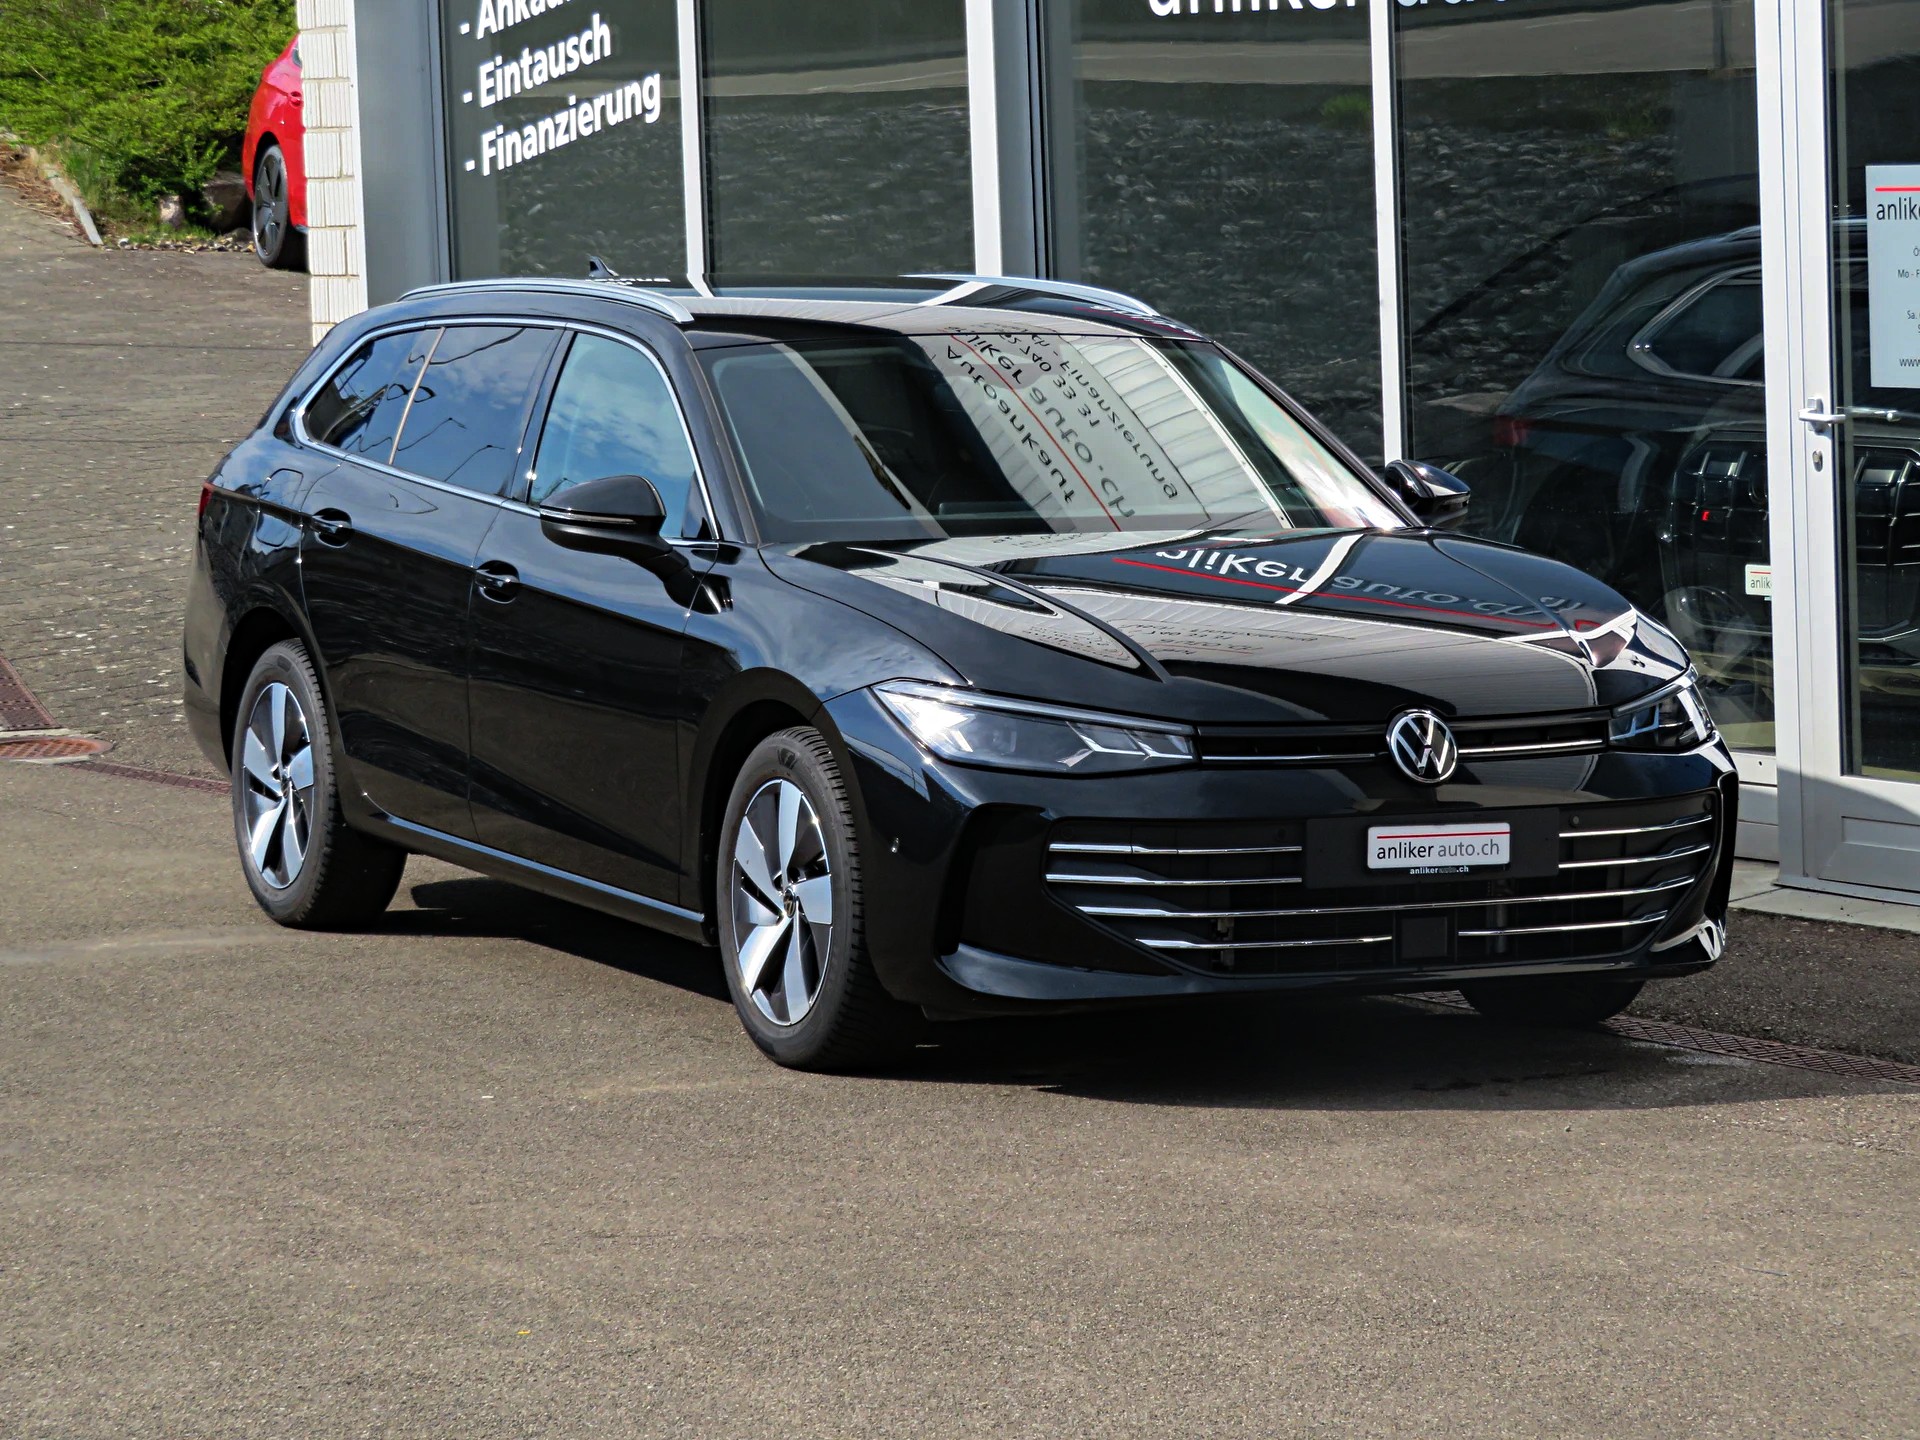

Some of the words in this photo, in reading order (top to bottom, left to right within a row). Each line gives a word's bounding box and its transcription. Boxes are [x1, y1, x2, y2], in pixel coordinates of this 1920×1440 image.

[478, 13, 612, 108] Eintausch
[480, 73, 661, 176] Finanzierung
[1876, 197, 1920, 220] anlik
[1897, 269, 1910, 279] Mo
[1750, 576, 1772, 589] anlik
[1376, 841, 1435, 860] anliker
[1437, 838, 1500, 858] auto.ch
